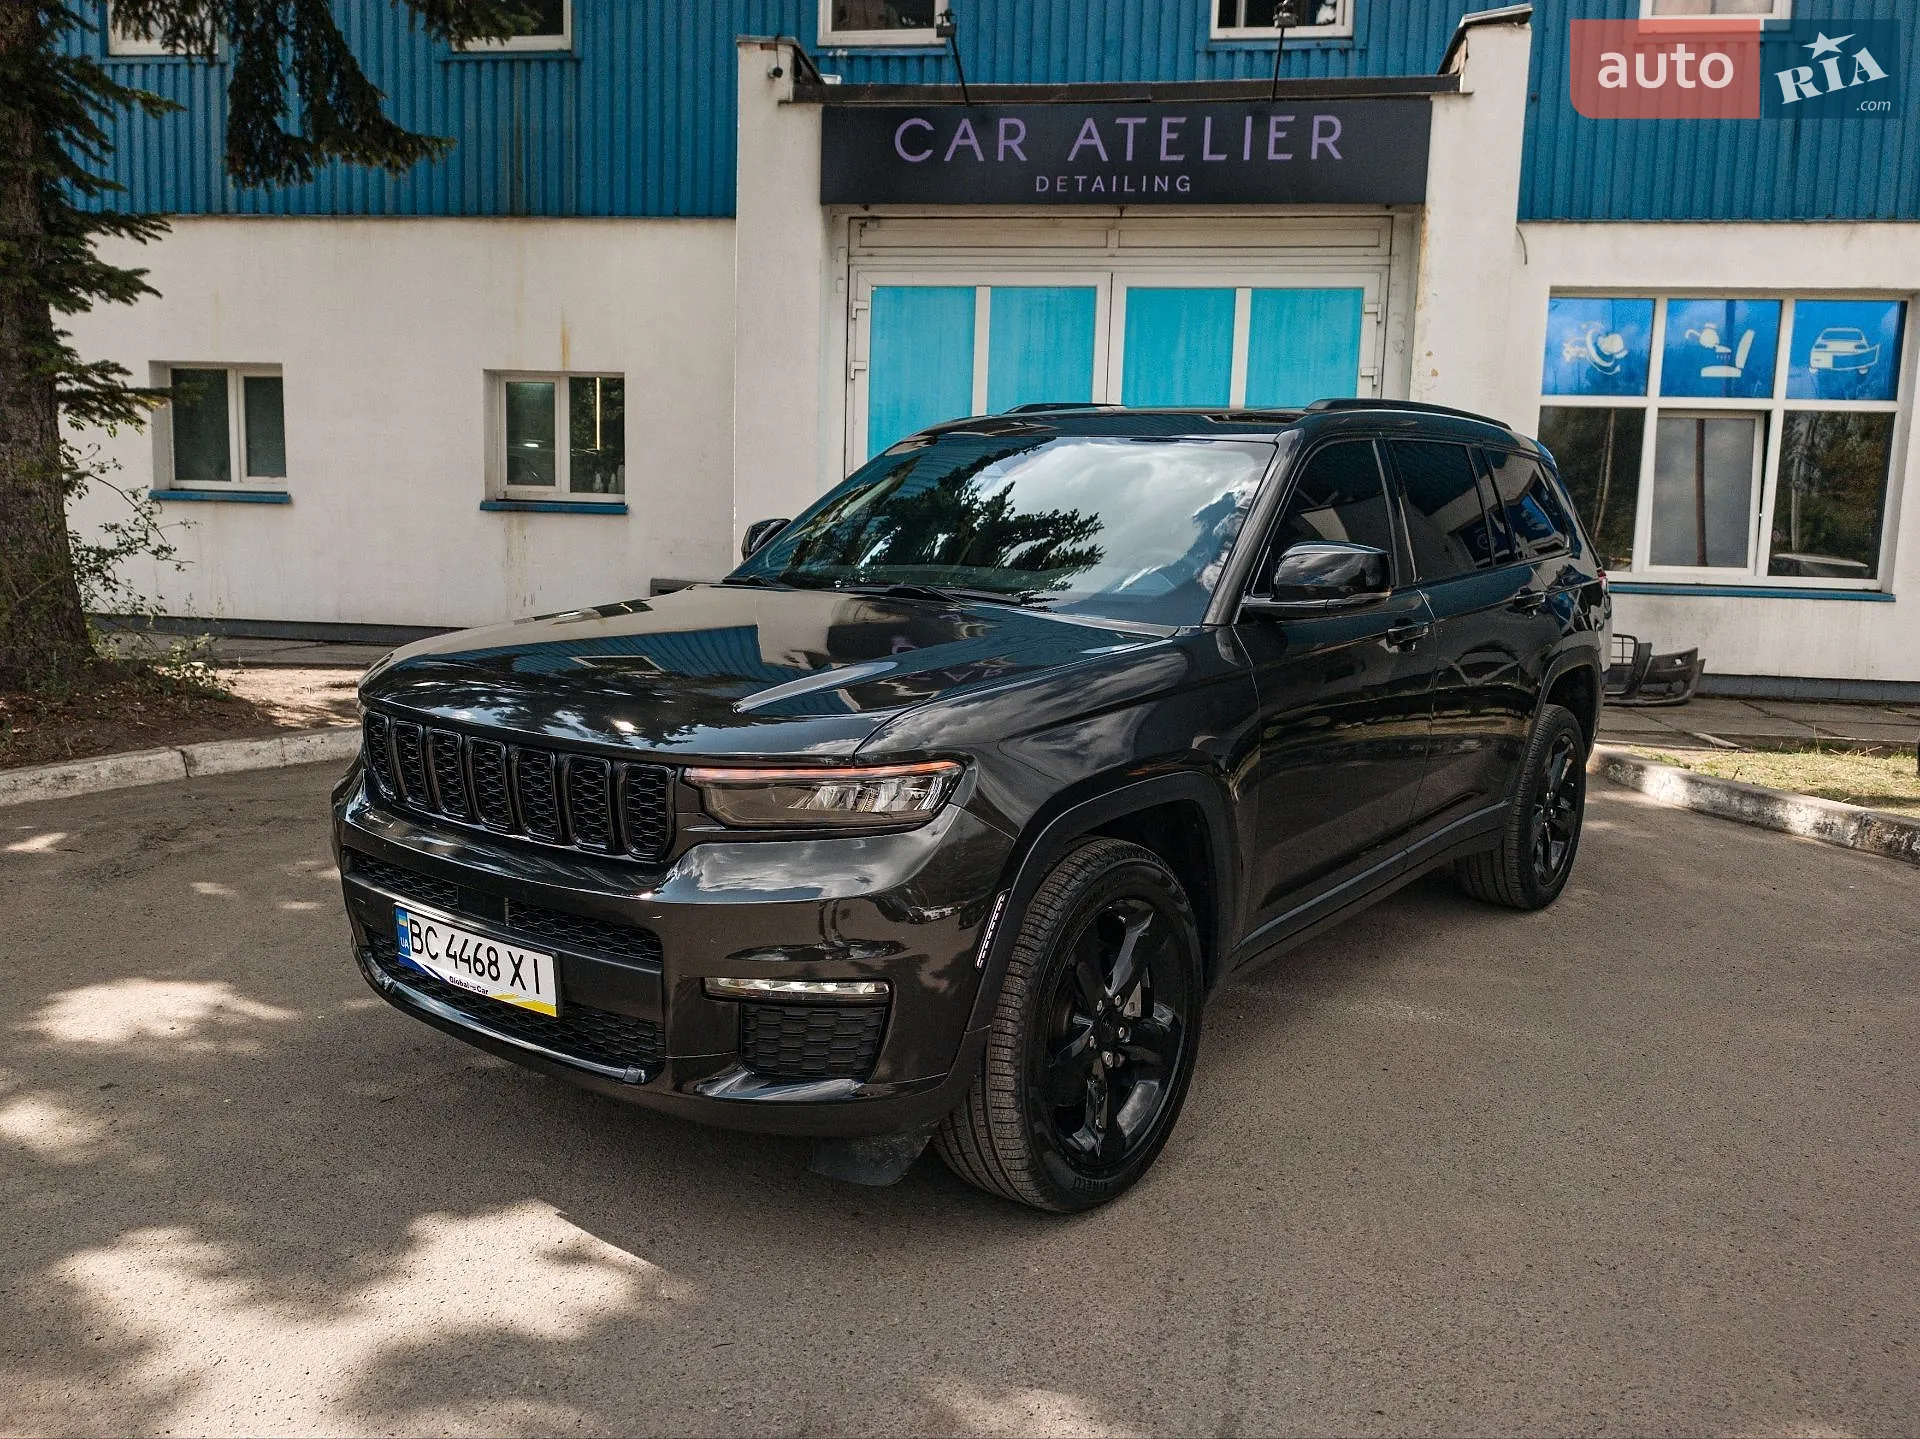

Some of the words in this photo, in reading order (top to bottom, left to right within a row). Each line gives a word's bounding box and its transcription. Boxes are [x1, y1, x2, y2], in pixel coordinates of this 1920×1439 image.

[894, 117, 1029, 163] CAR
[1067, 114, 1343, 162] ATELIER
[1035, 175, 1192, 193] DETAILING
[400, 938, 409, 949] UA
[409, 919, 438, 960] BC
[446, 934, 501, 981] 4468
[508, 950, 540, 994] XI
